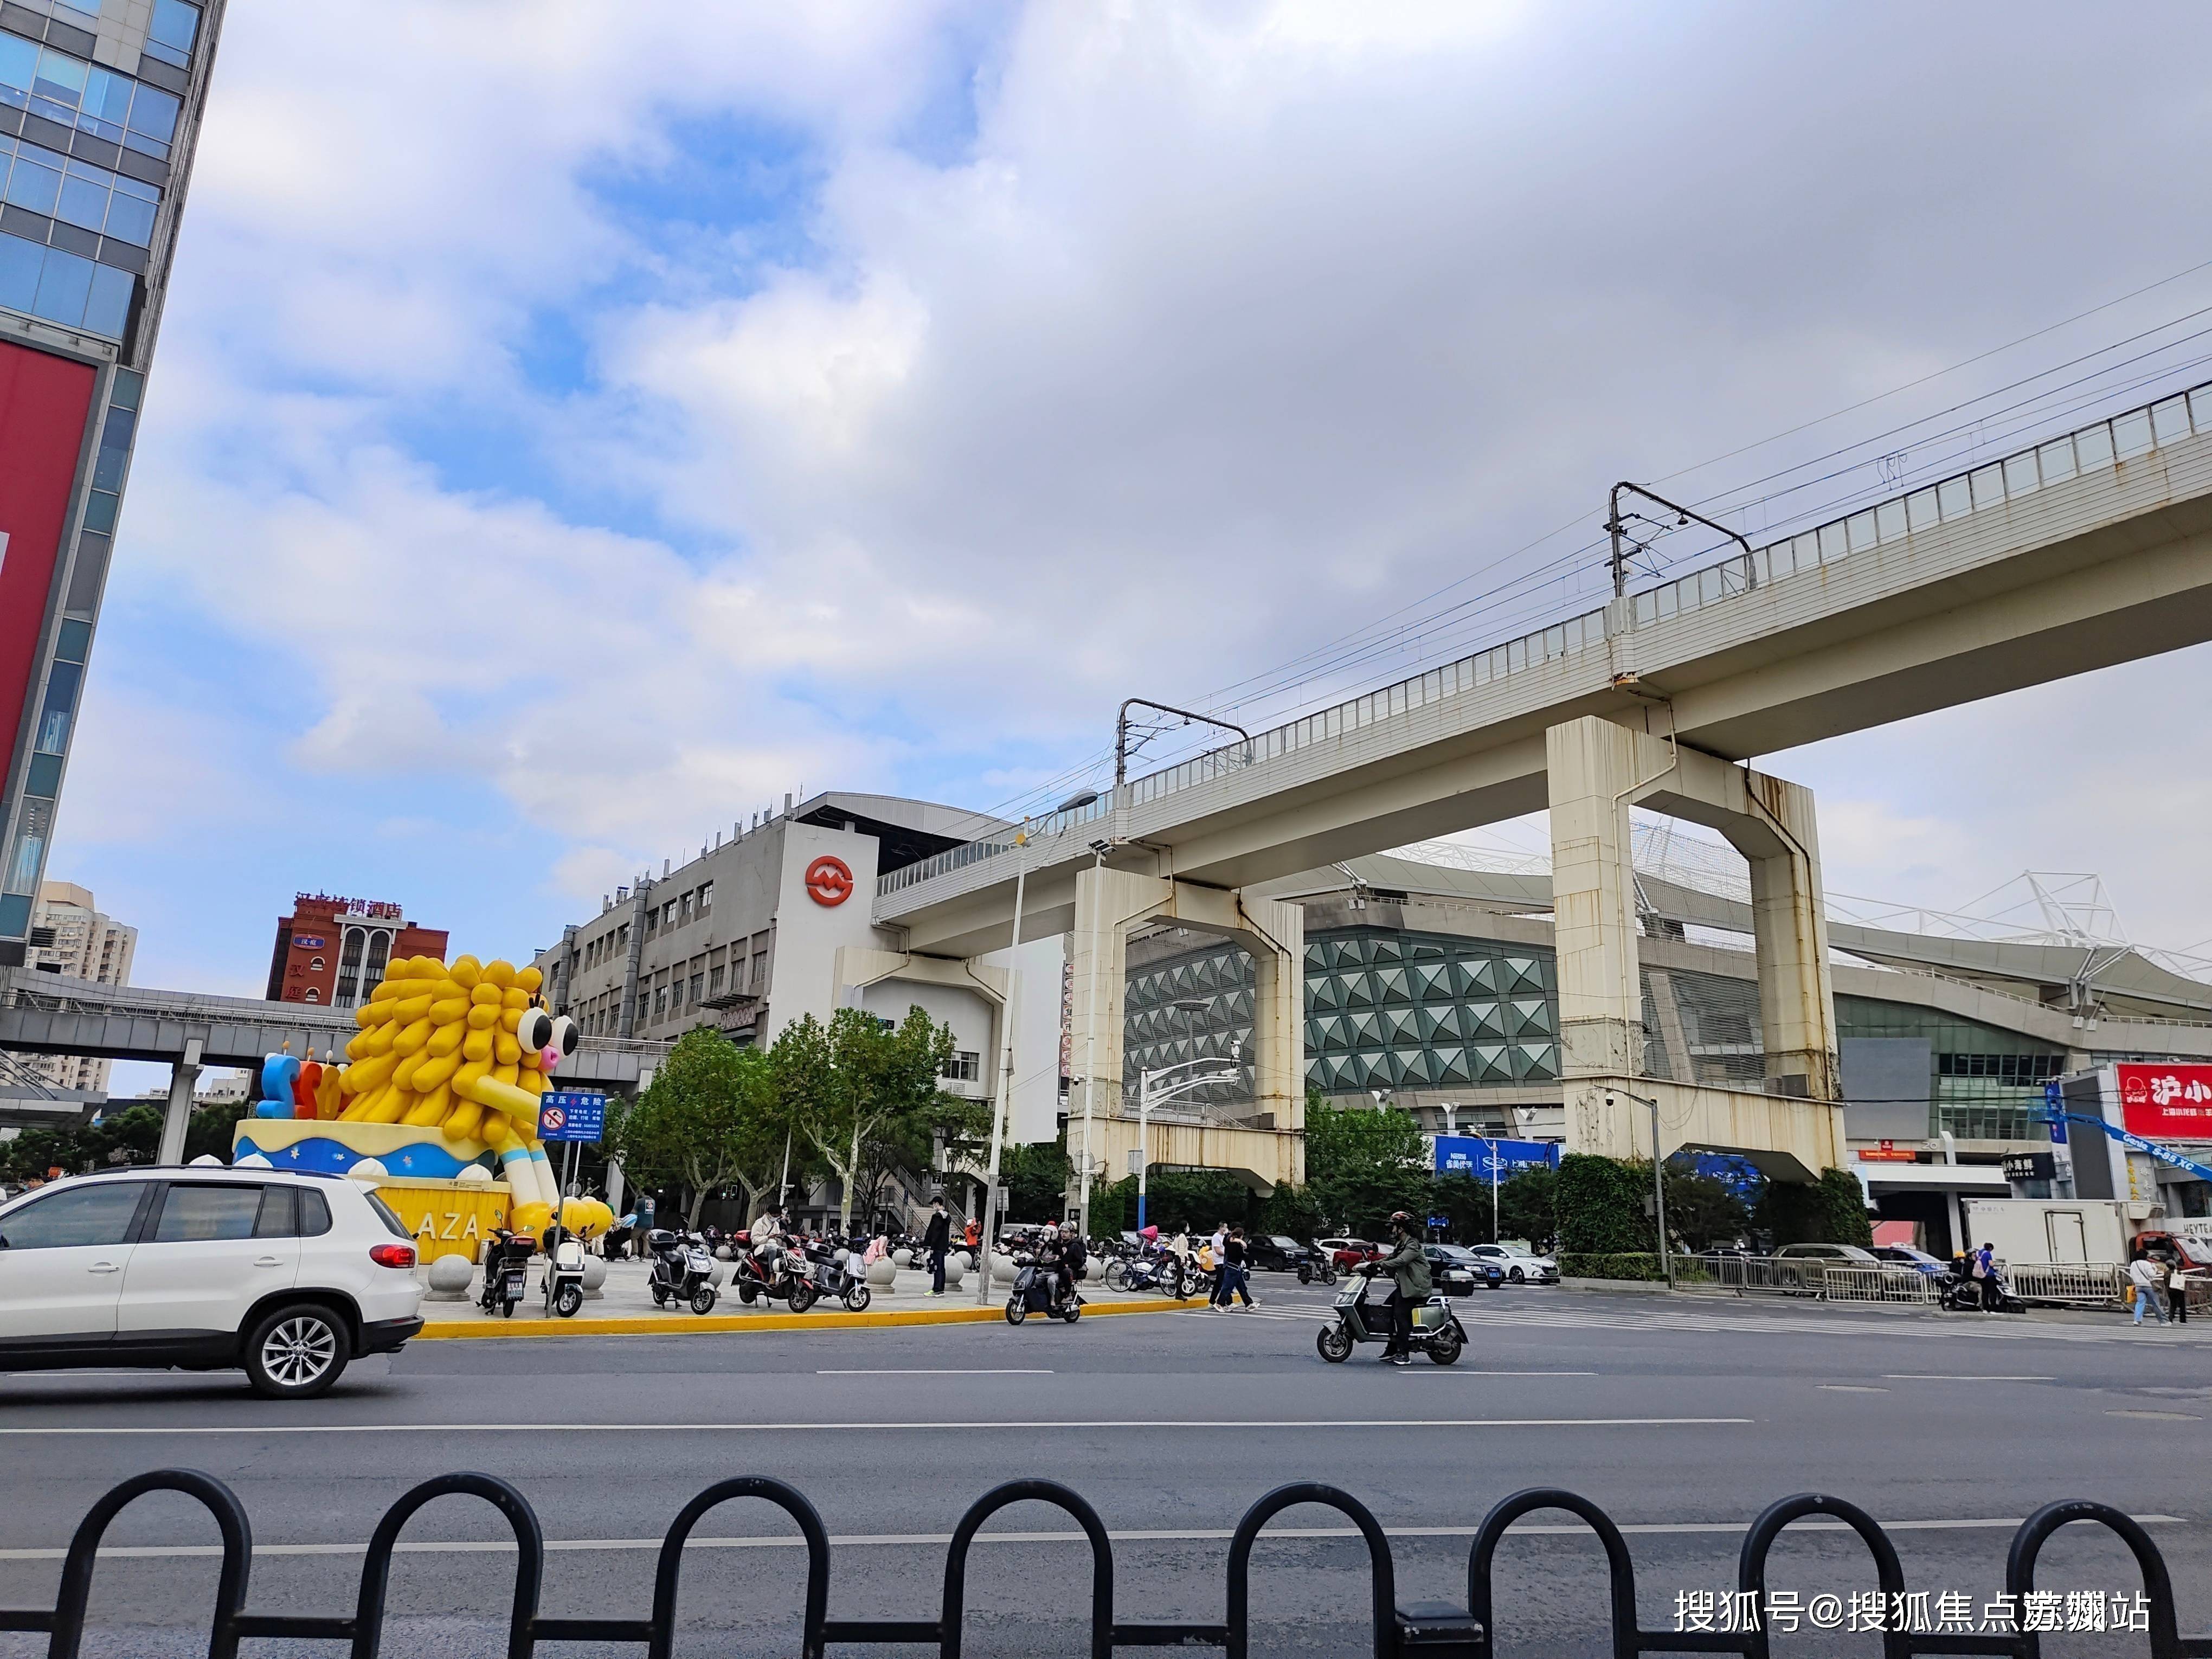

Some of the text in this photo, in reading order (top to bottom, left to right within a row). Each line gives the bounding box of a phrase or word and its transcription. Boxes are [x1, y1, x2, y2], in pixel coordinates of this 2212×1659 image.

[546, 1095, 601, 1105] 高压 危险
[2150, 1075, 2212, 1105] 沪小
[1921, 1141, 1939, 1149] 20
[2123, 1134, 2195, 1171] Genie S-85 XC
[397, 1212, 479, 1240] AZA
